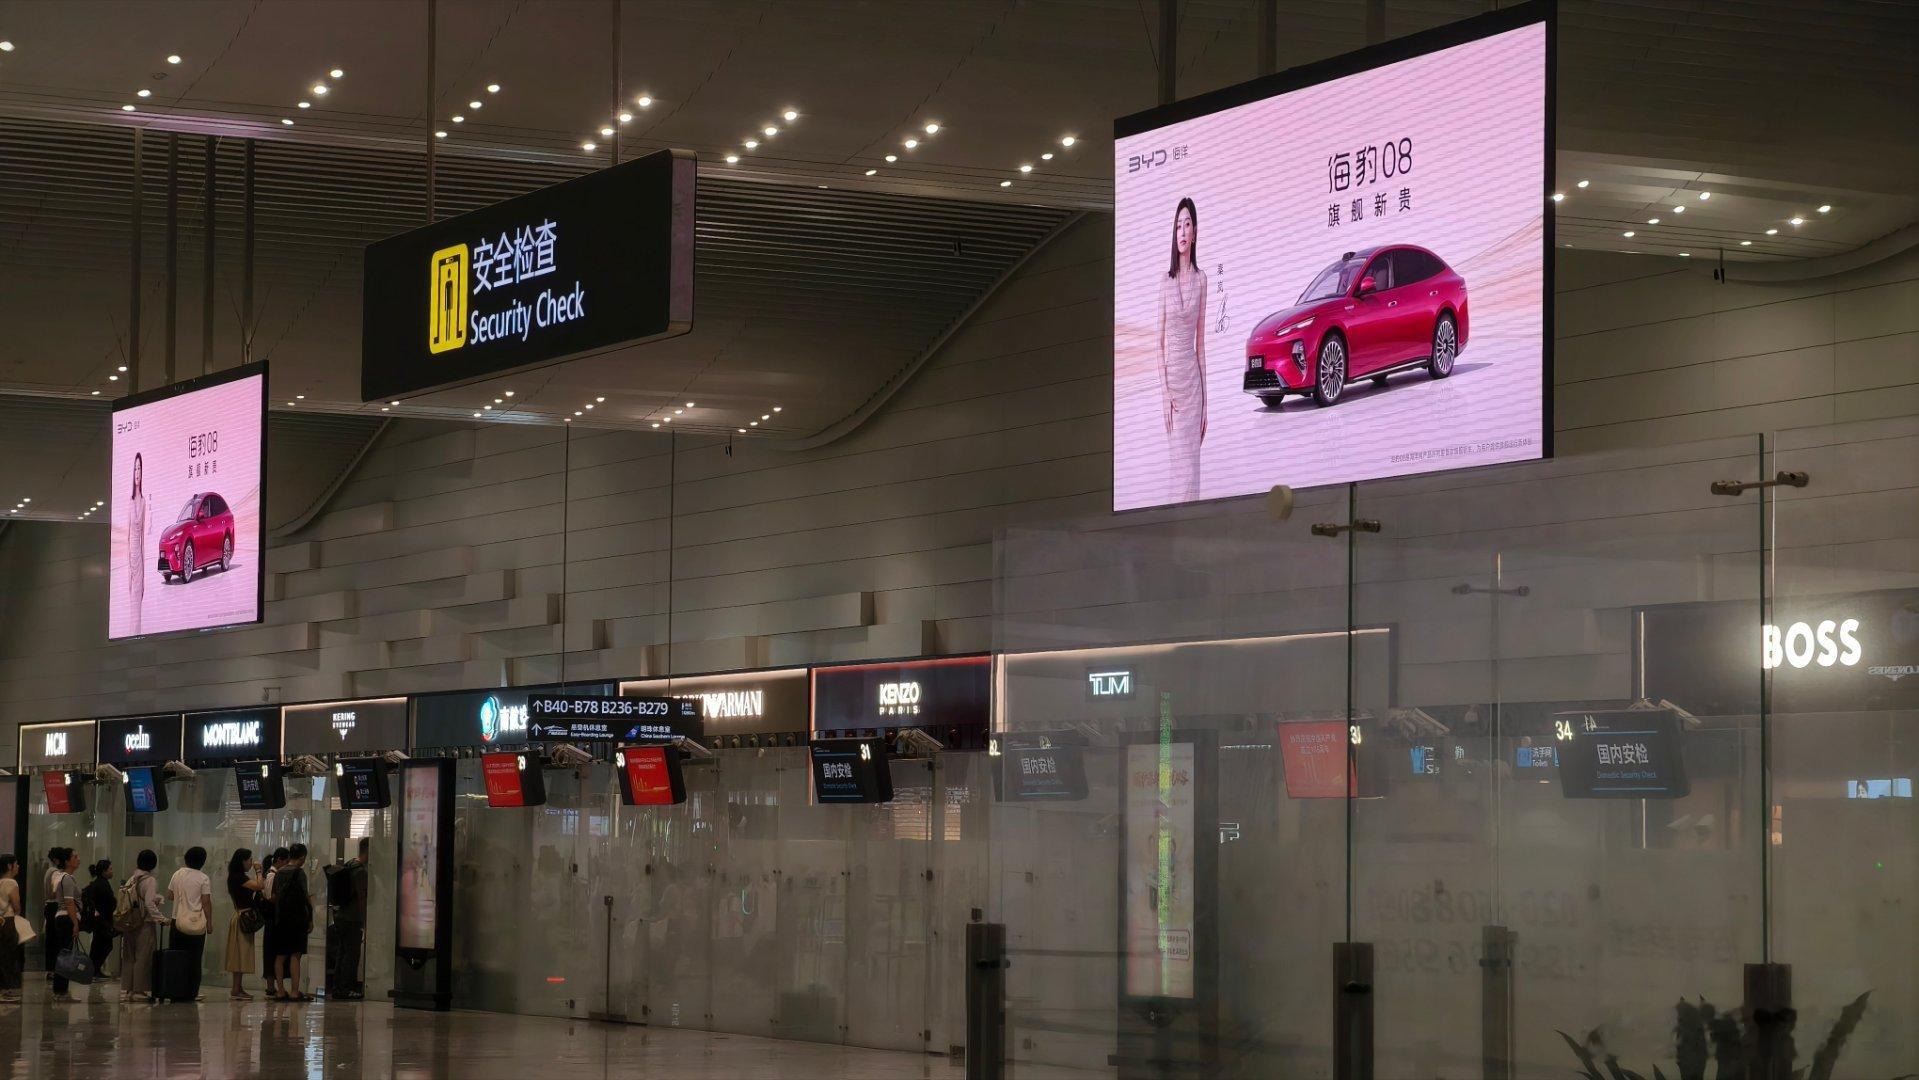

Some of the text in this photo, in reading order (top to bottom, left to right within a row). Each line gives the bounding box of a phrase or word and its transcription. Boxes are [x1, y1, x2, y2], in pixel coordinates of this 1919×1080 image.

[1129, 149, 1167, 173] BYD
[1328, 137, 1412, 194] 海豹08
[473, 218, 557, 296] 安全检查
[470, 280, 585, 345] Security Check
[1762, 618, 1863, 669] BOSS
[878, 681, 920, 705] KENZO
[1089, 671, 1130, 695] TUMI
[544, 700, 598, 714] B40-B78
[601, 700, 669, 715] B236-B279
[720, 690, 762, 717] ARMANI
[878, 705, 920, 716] PARIS
[203, 721, 260, 747] MONTBLANC
[1555, 720, 1573, 741] 34
[1021, 757, 1057, 774] 国内安检
[1596, 743, 1649, 764] 国内安检
[822, 762, 853, 779] 国内安检
